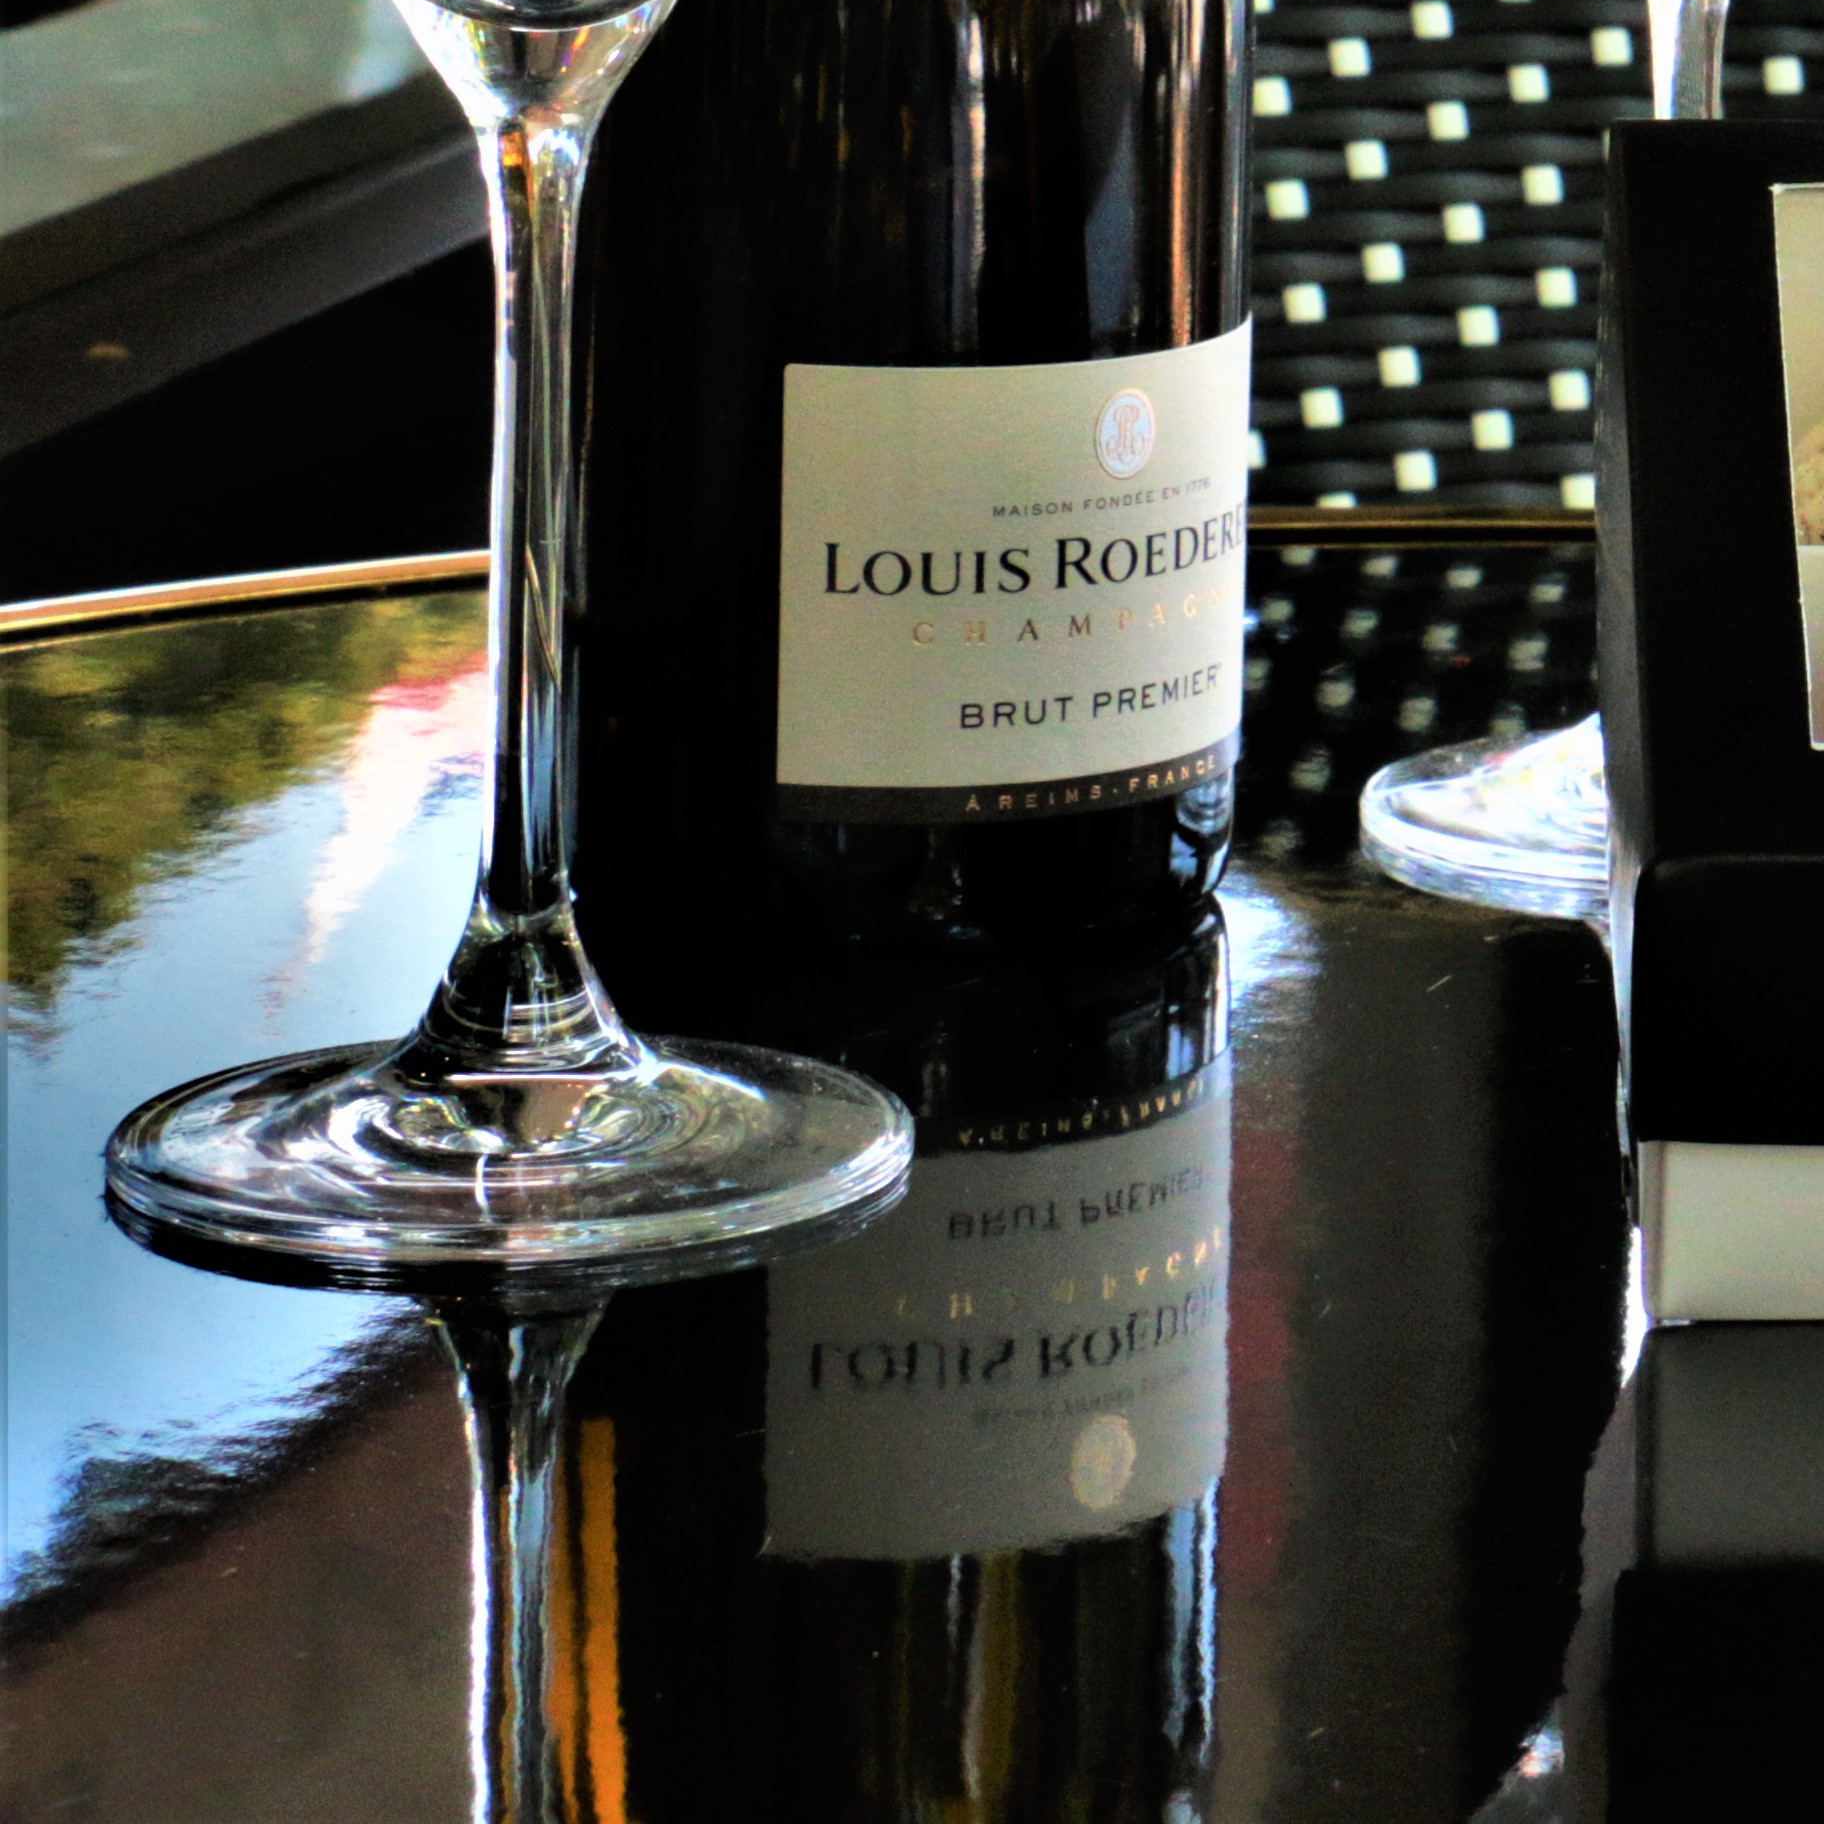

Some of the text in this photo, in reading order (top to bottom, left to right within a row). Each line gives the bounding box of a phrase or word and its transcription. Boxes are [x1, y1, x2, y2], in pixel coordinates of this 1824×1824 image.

[991, 501, 1073, 518] MAISON
[1082, 489, 1155, 511] FONDÉE
[1161, 485, 1180, 500] EN
[823, 541, 1031, 597] LOUIS
[959, 663, 1222, 730] BRUT PREMIER
